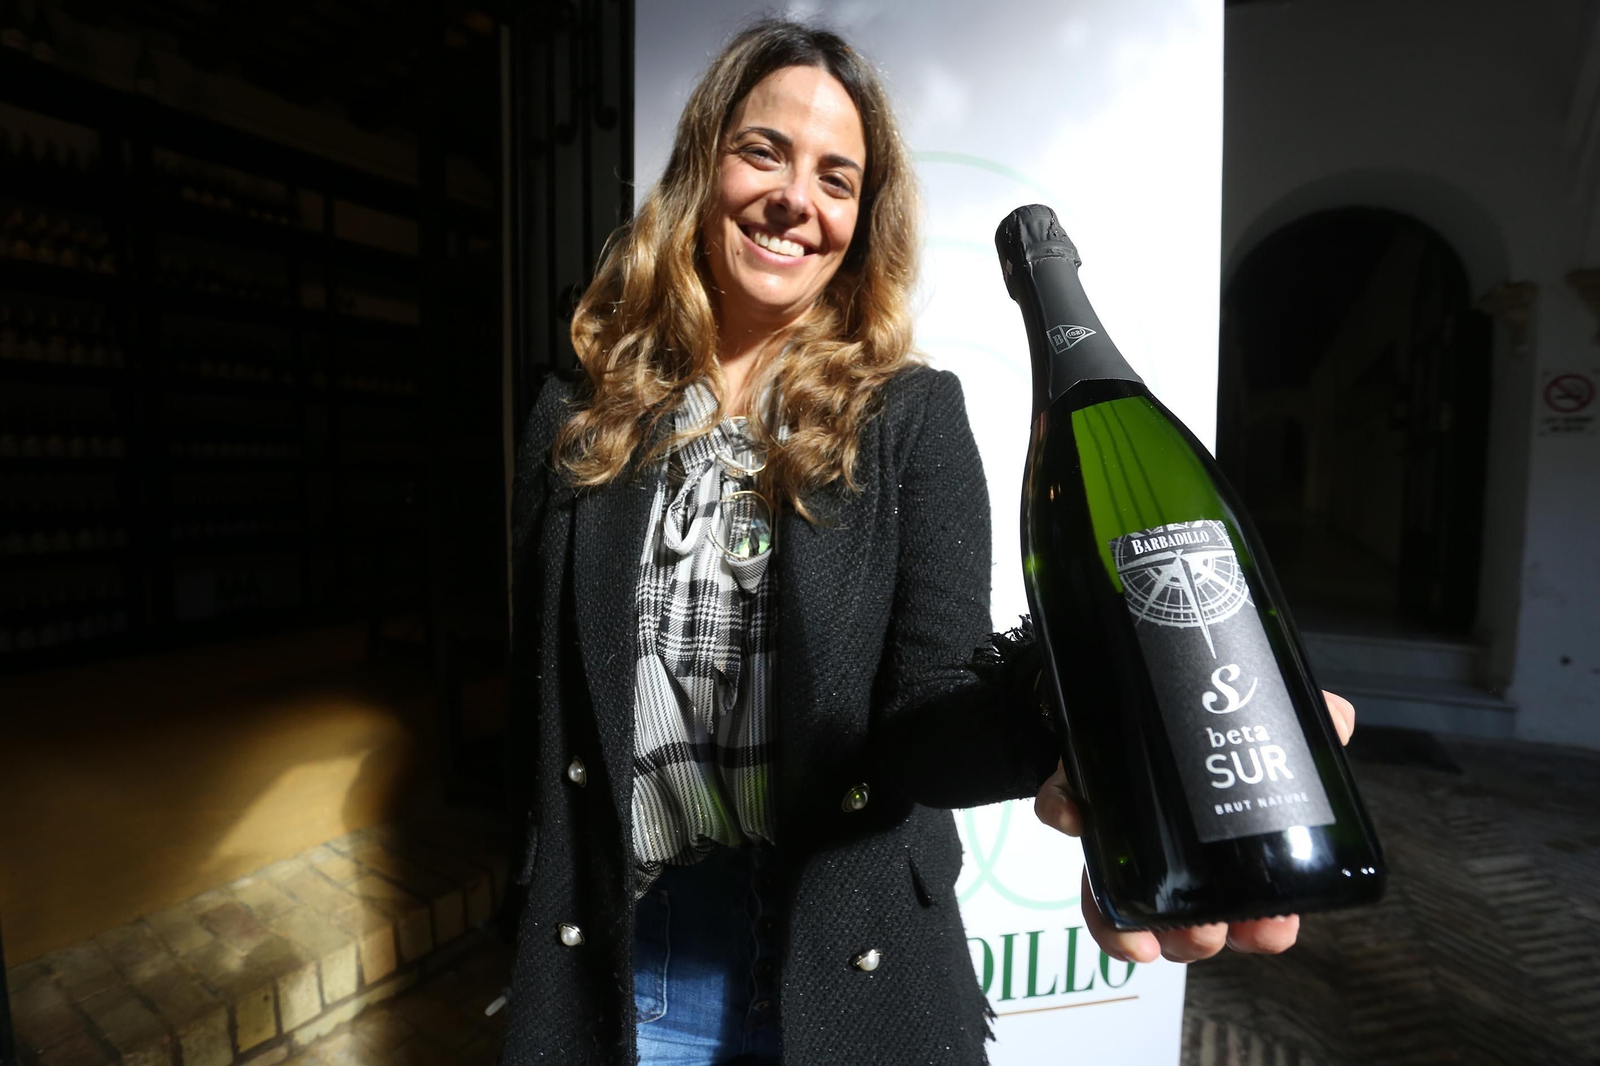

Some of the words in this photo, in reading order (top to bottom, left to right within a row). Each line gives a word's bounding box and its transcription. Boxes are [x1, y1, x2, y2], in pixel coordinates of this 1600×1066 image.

[1131, 530, 1210, 555] BARBADILLO
[1206, 724, 1271, 748] beta
[1205, 745, 1294, 789] SUR
[1214, 800, 1252, 816] BRUT
[1257, 792, 1310, 808] NATURE
